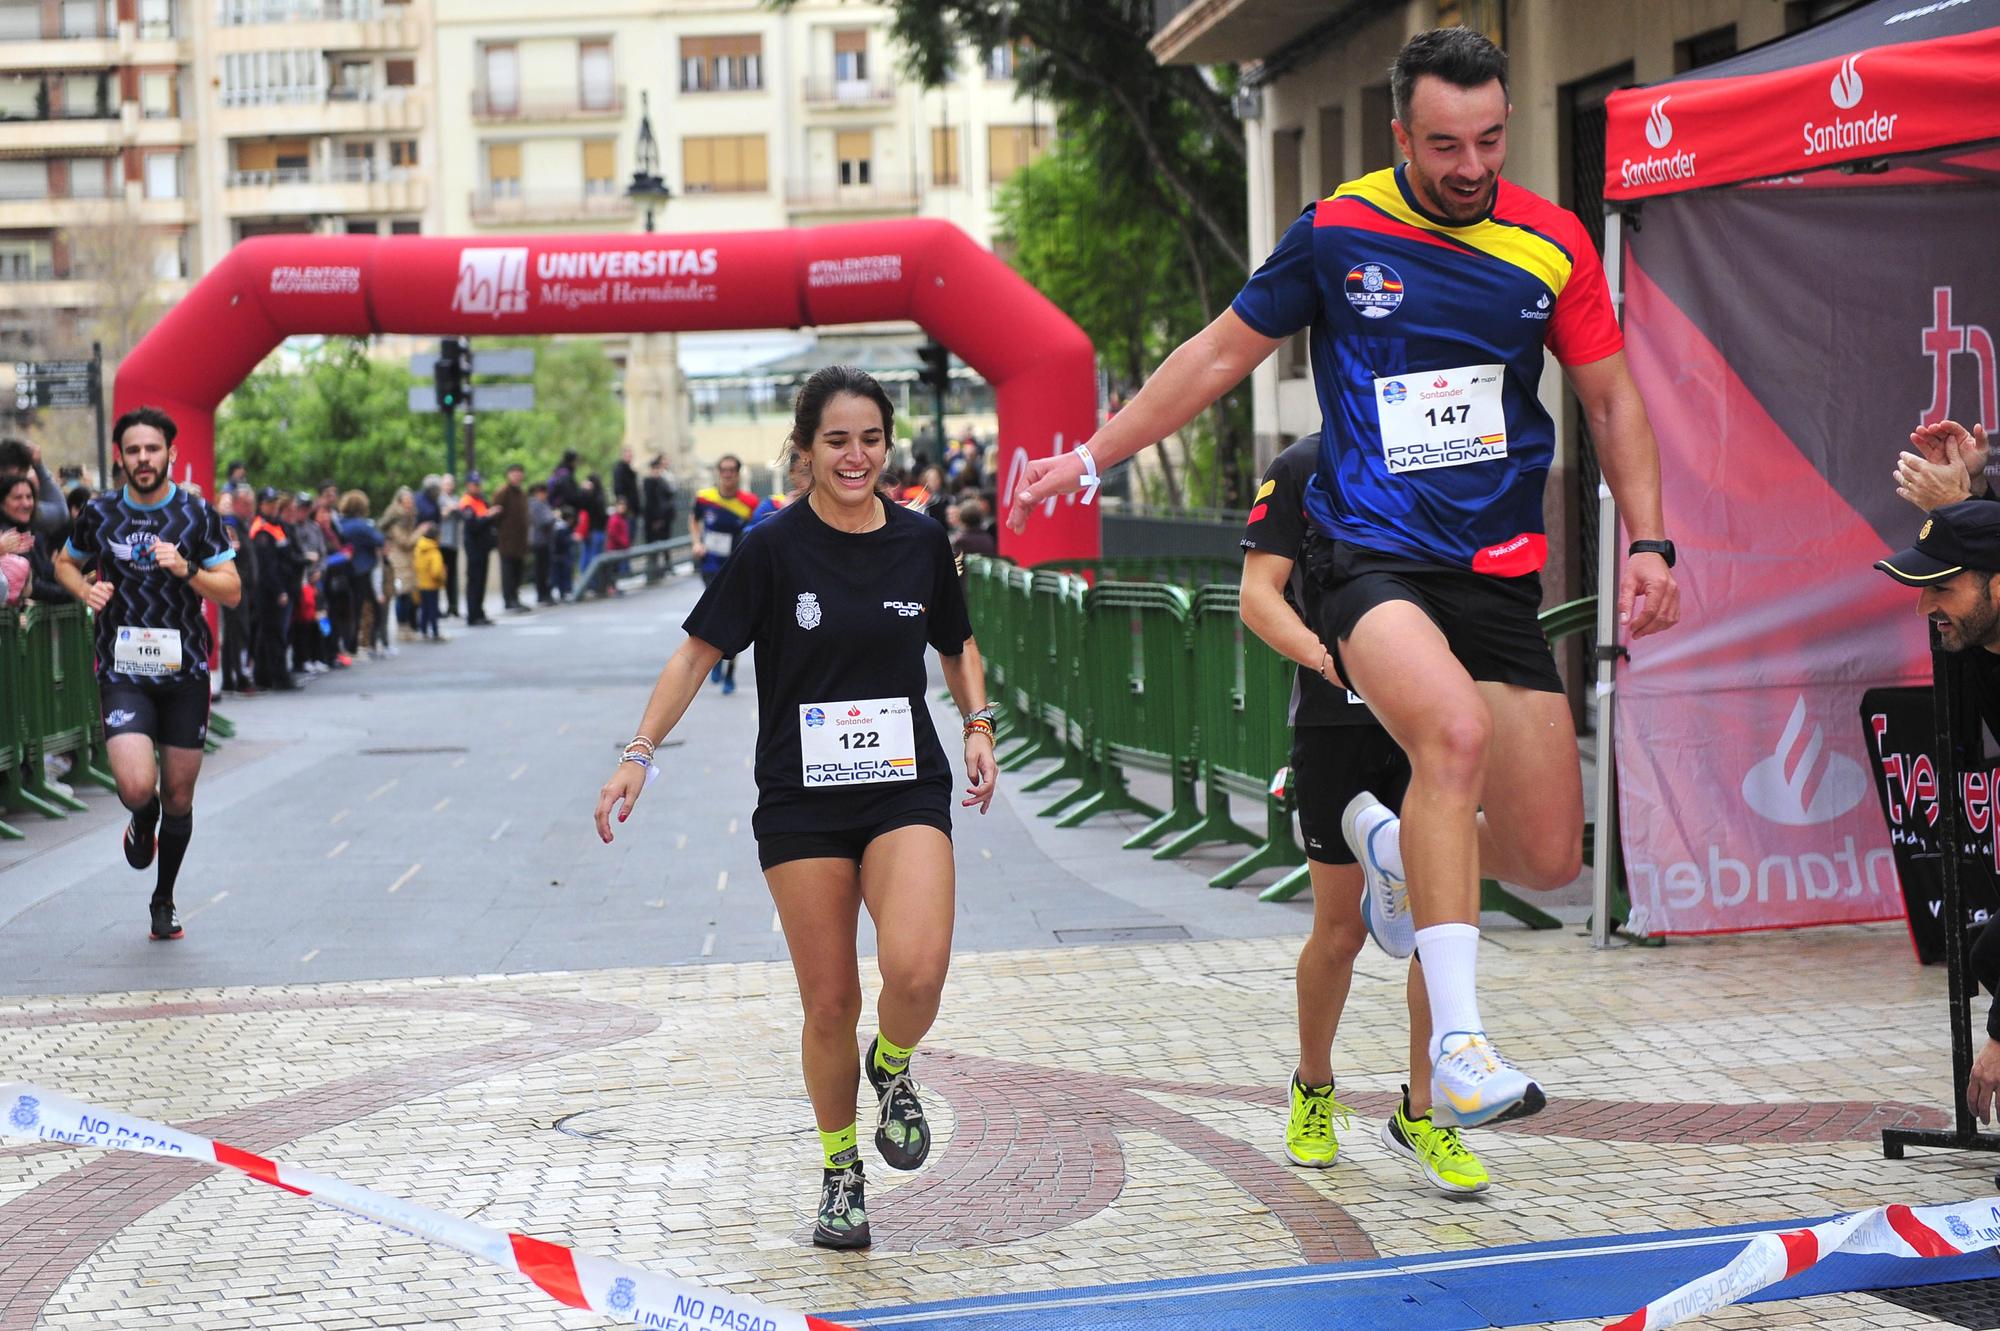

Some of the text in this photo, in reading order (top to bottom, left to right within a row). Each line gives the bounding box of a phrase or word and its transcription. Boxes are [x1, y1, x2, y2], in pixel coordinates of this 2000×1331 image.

[1803, 111, 1898, 156] Santander
[1621, 149, 1697, 188] Santander
[537, 249, 718, 279] UNIVERSITAS
[540, 279, 718, 310] Miguel Hernández
[1419, 388, 1465, 400] Santander
[1425, 404, 1471, 427] 147
[1387, 436, 1484, 458] POLICIA
[1389, 445, 1506, 469] NACIONAL
[883, 601, 923, 610] POLICIA
[898, 609, 919, 617] CNP
[137, 646, 161, 656] 166
[835, 718, 873, 727] Santander
[839, 731, 880, 749] 122
[806, 759, 892, 773] POLICIA
[806, 768, 916, 783] NACIONAL
[79, 1115, 110, 1135] NO
[673, 1295, 705, 1320] NO
